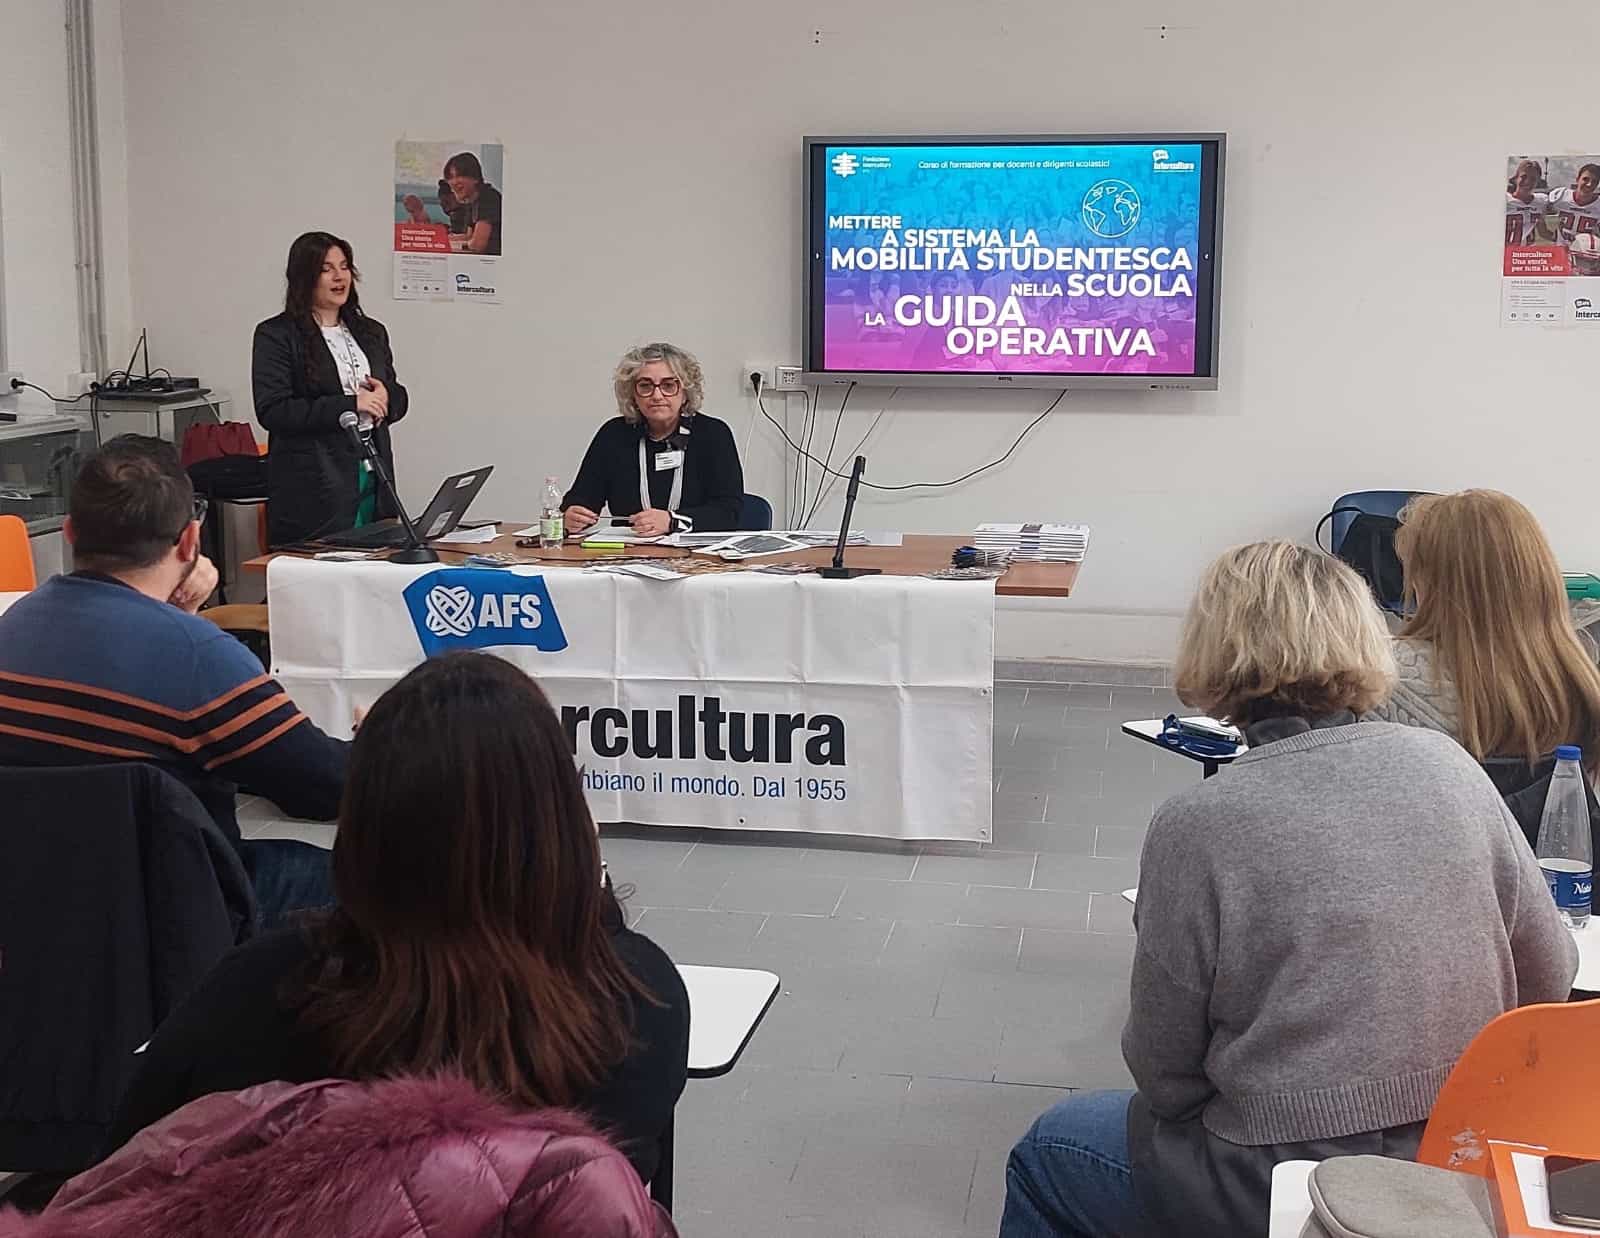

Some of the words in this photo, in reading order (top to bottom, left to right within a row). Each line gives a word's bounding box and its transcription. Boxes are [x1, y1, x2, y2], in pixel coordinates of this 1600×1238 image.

[918, 160, 940, 169] Corso
[940, 160, 948, 169] di
[949, 160, 991, 169] formazione
[992, 161, 1005, 170] per
[1006, 160, 1035, 169] docenti
[1042, 159, 1075, 169] dirigenti
[1075, 159, 1110, 168] scolastici
[829, 215, 902, 229] METTERE
[881, 229, 899, 247] A
[904, 228, 1003, 248] SISTEMA
[1009, 229, 1040, 248] LA
[976, 246, 1193, 272] STUDENTESCA
[456, 286, 496, 294] Intercultura
[1010, 283, 1063, 297] NELLA
[1067, 273, 1193, 297] SCUOLA
[864, 312, 886, 326] LA
[894, 294, 1027, 328] GUIDA
[946, 326, 1156, 356] OPERATIVA
[478, 594, 541, 629] AFS
[561, 695, 847, 766] rcultura
[583, 770, 646, 792] biano
[653, 772, 663, 793] il
[671, 774, 745, 797] mondo.
[753, 776, 786, 798] Dal
[794, 777, 847, 801] 1955
